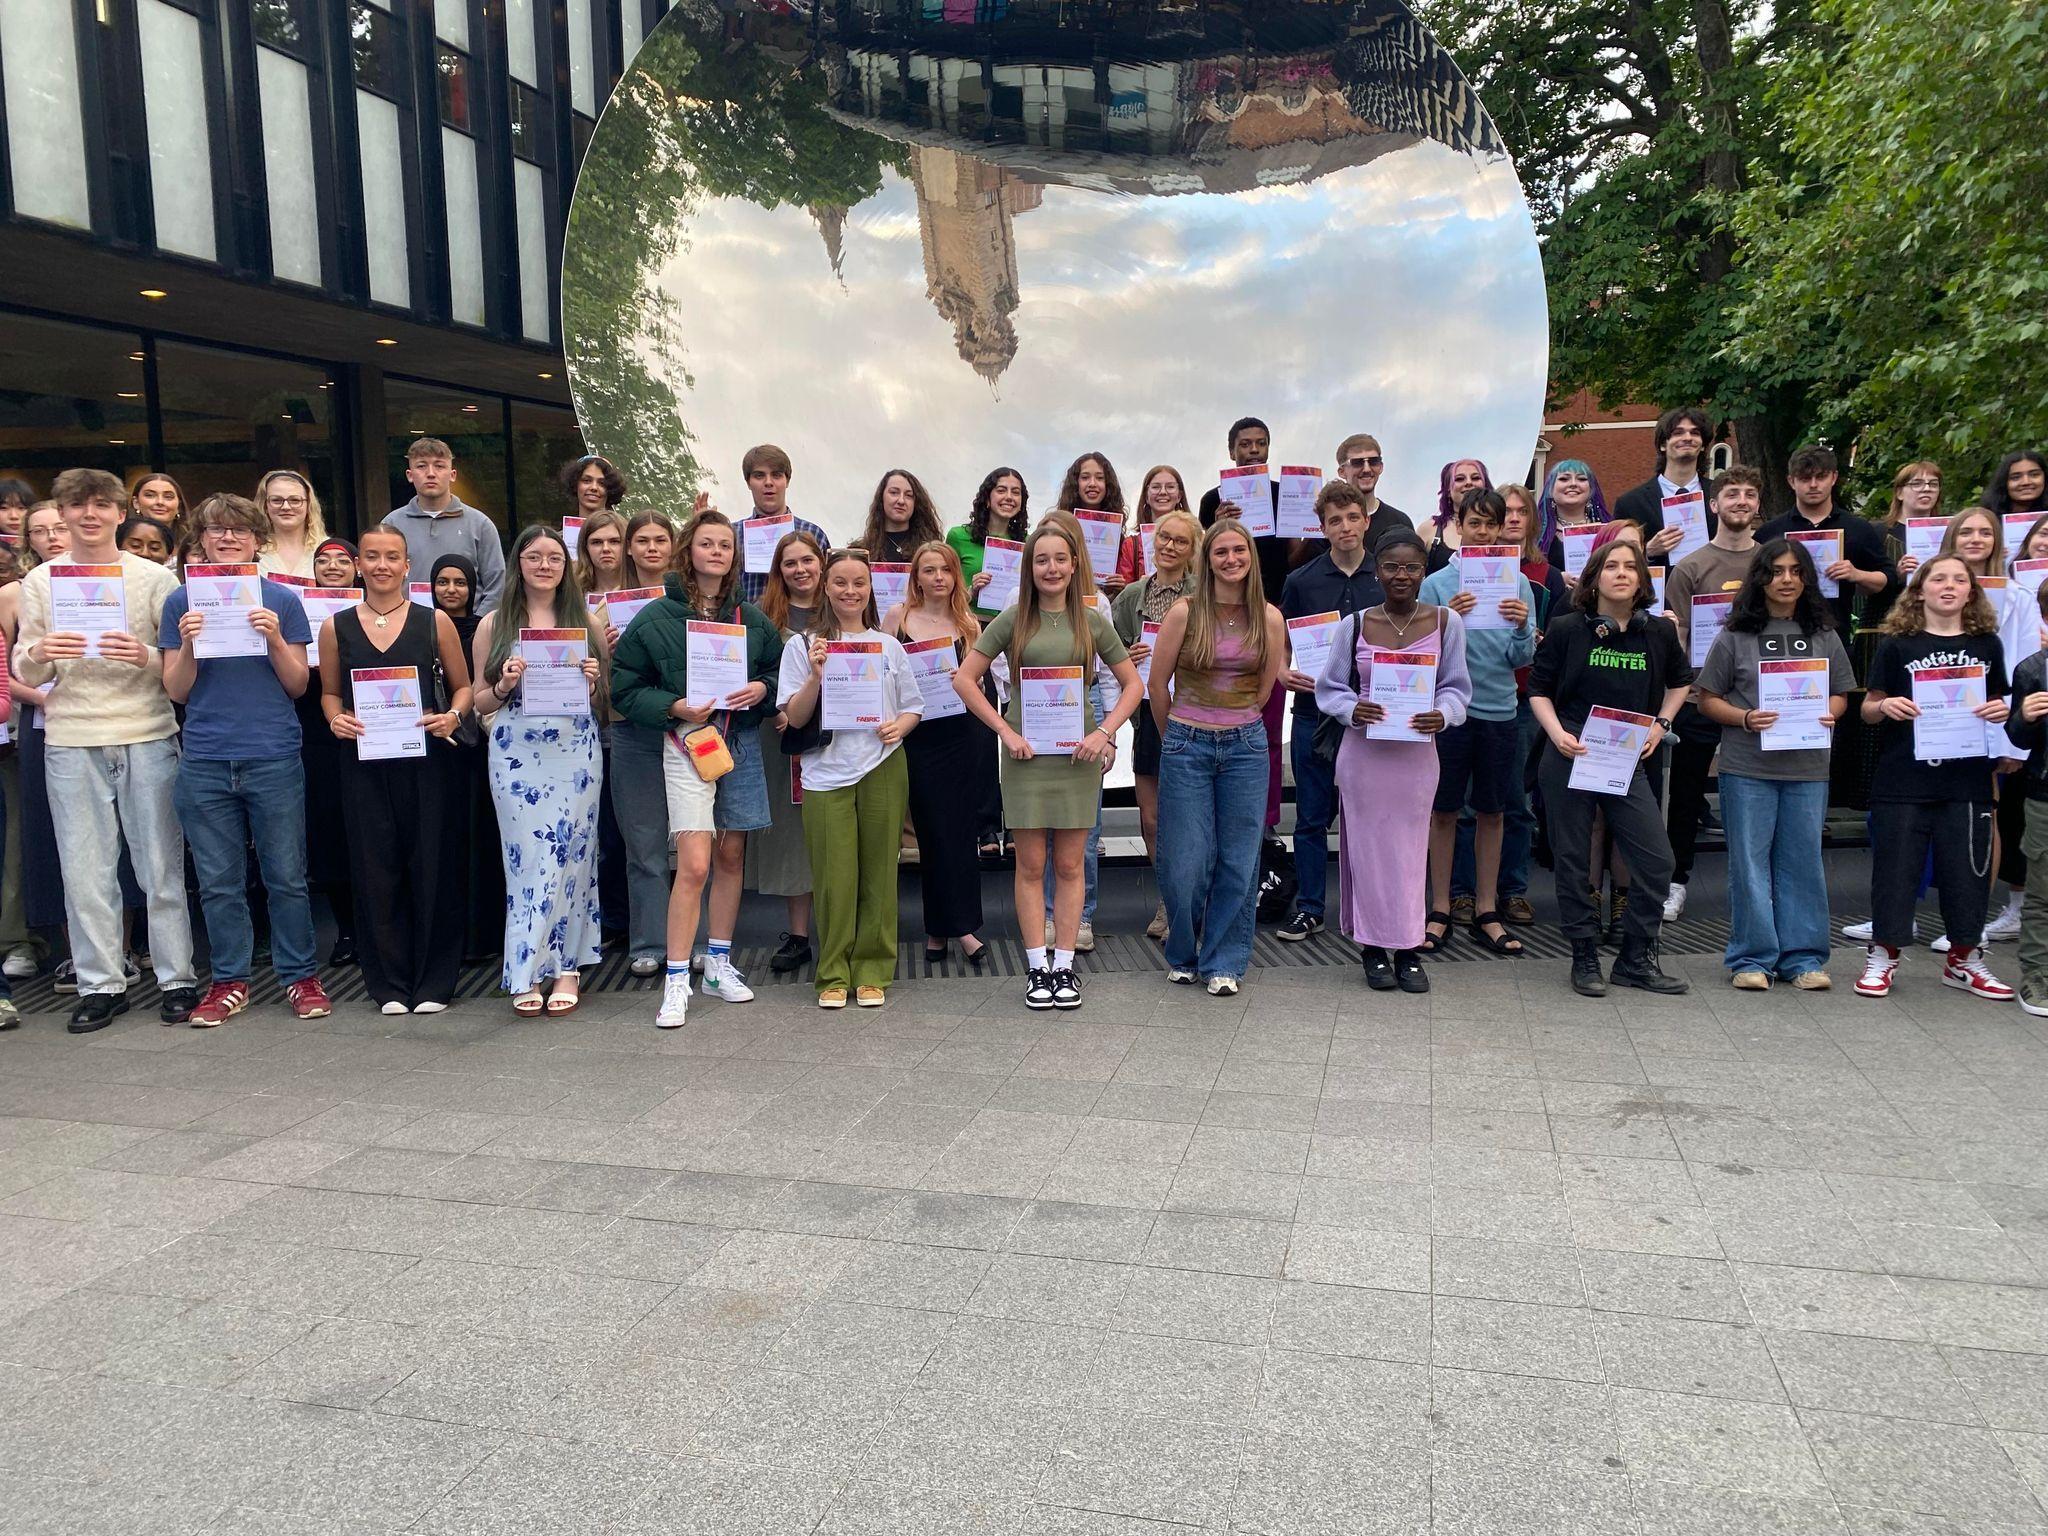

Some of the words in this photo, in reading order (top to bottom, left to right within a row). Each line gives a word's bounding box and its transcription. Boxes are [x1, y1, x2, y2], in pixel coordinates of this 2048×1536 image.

[1766, 640, 1778, 650] C
[1794, 640, 1807, 651] O
[1591, 646, 1646, 658] Achievement
[1589, 654, 1646, 670] HUNTER
[380, 702, 417, 710] COMMENDED
